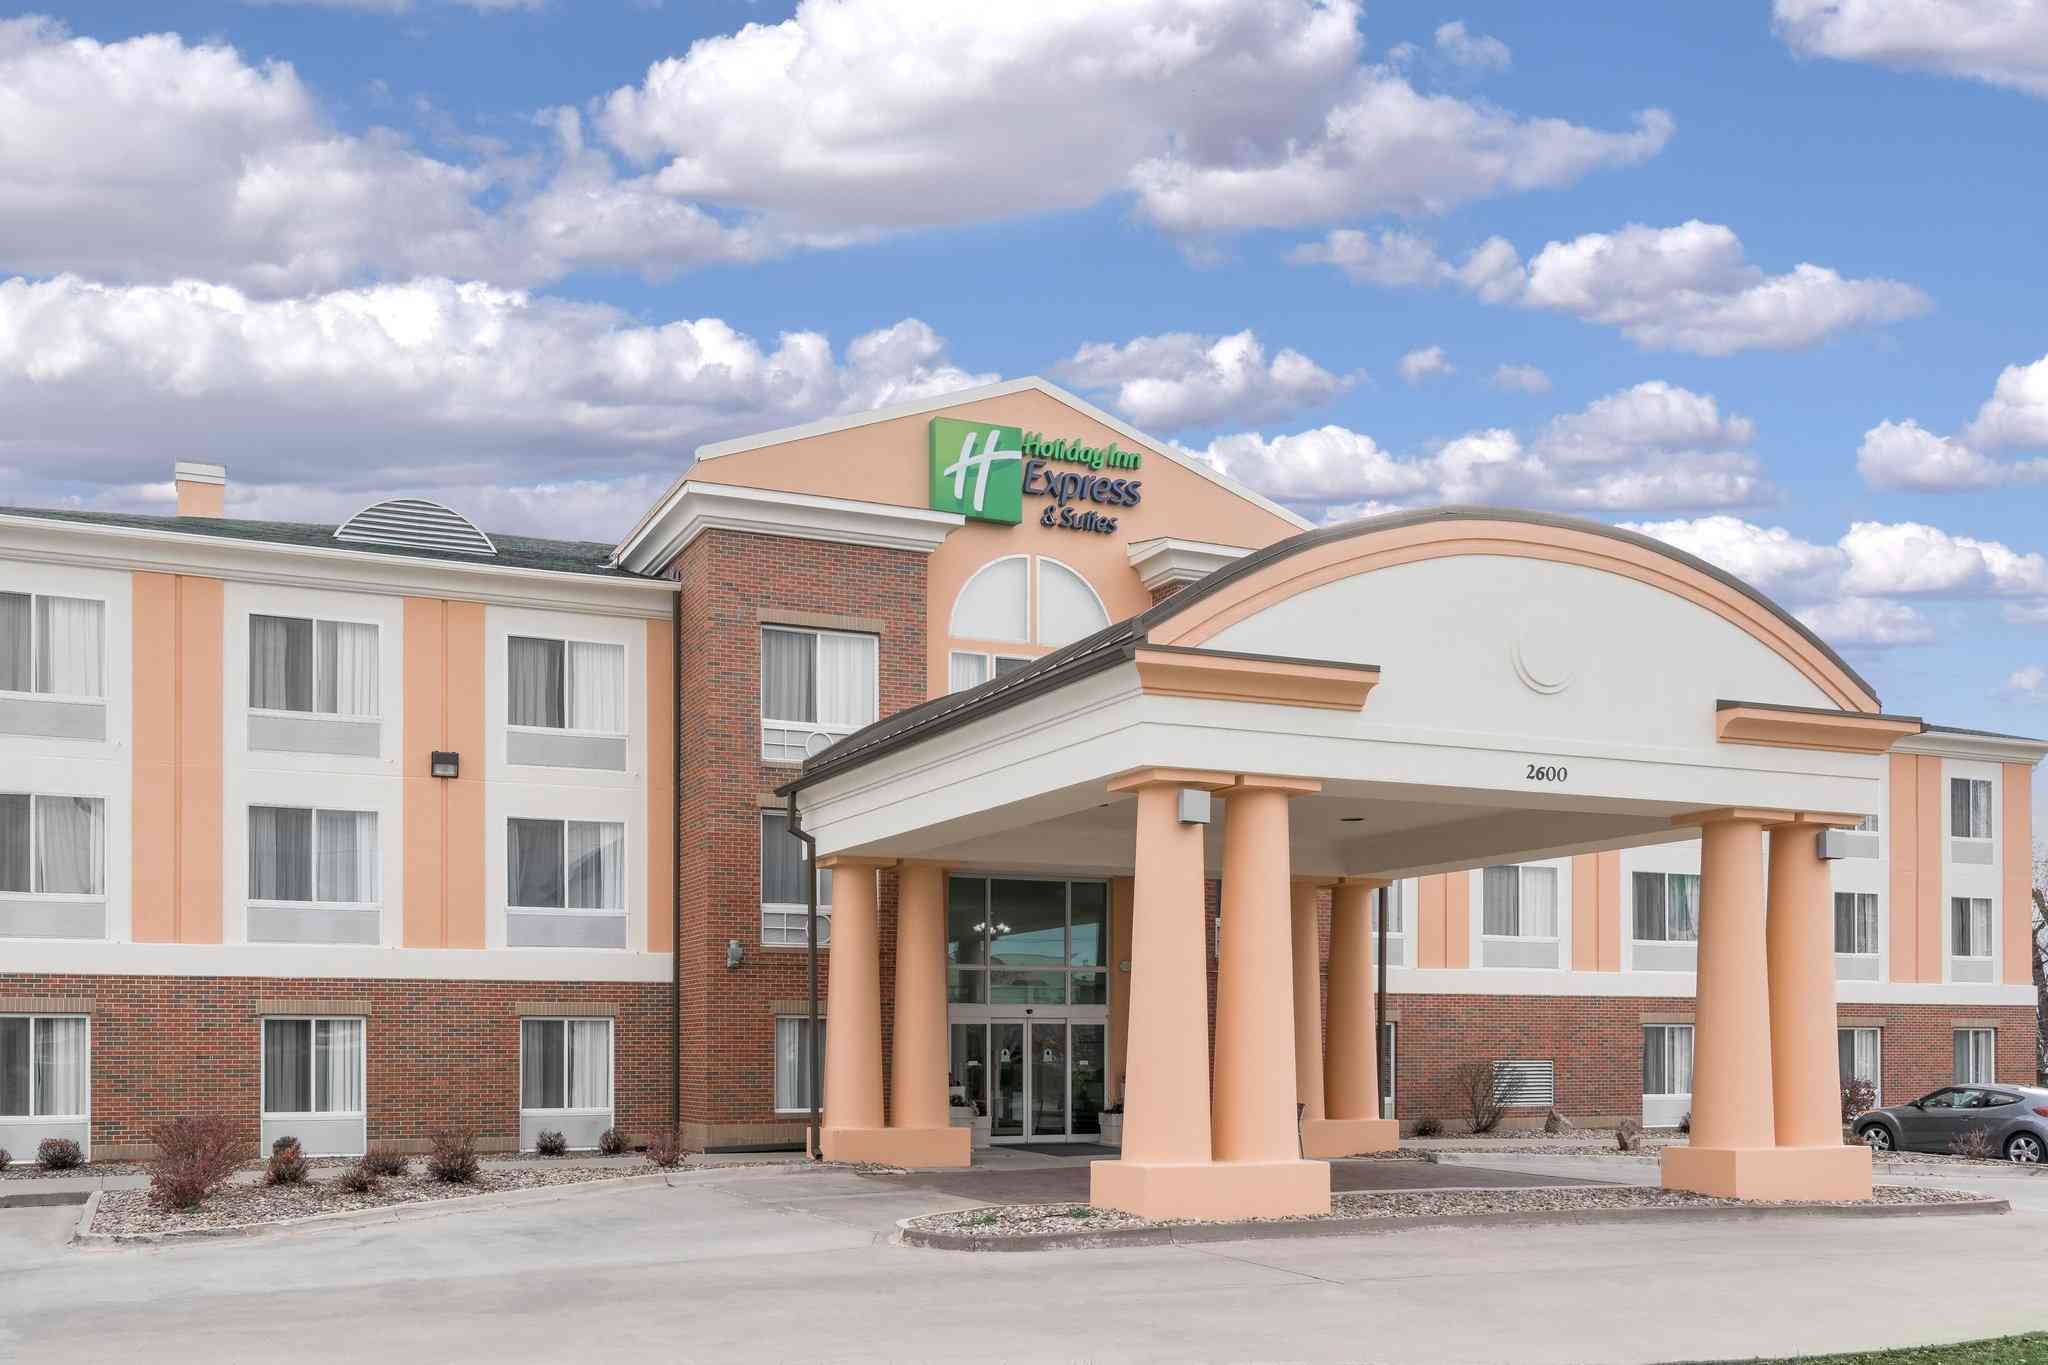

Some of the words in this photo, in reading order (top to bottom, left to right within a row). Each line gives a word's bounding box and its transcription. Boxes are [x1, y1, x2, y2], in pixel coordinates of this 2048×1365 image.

[1023, 431, 1104, 470] Holiday
[1106, 443, 1142, 470] Inn
[1022, 459, 1142, 507] Express
[1040, 505, 1056, 528] &
[1058, 507, 1118, 534] Suites
[1526, 764, 1568, 782] 2600
